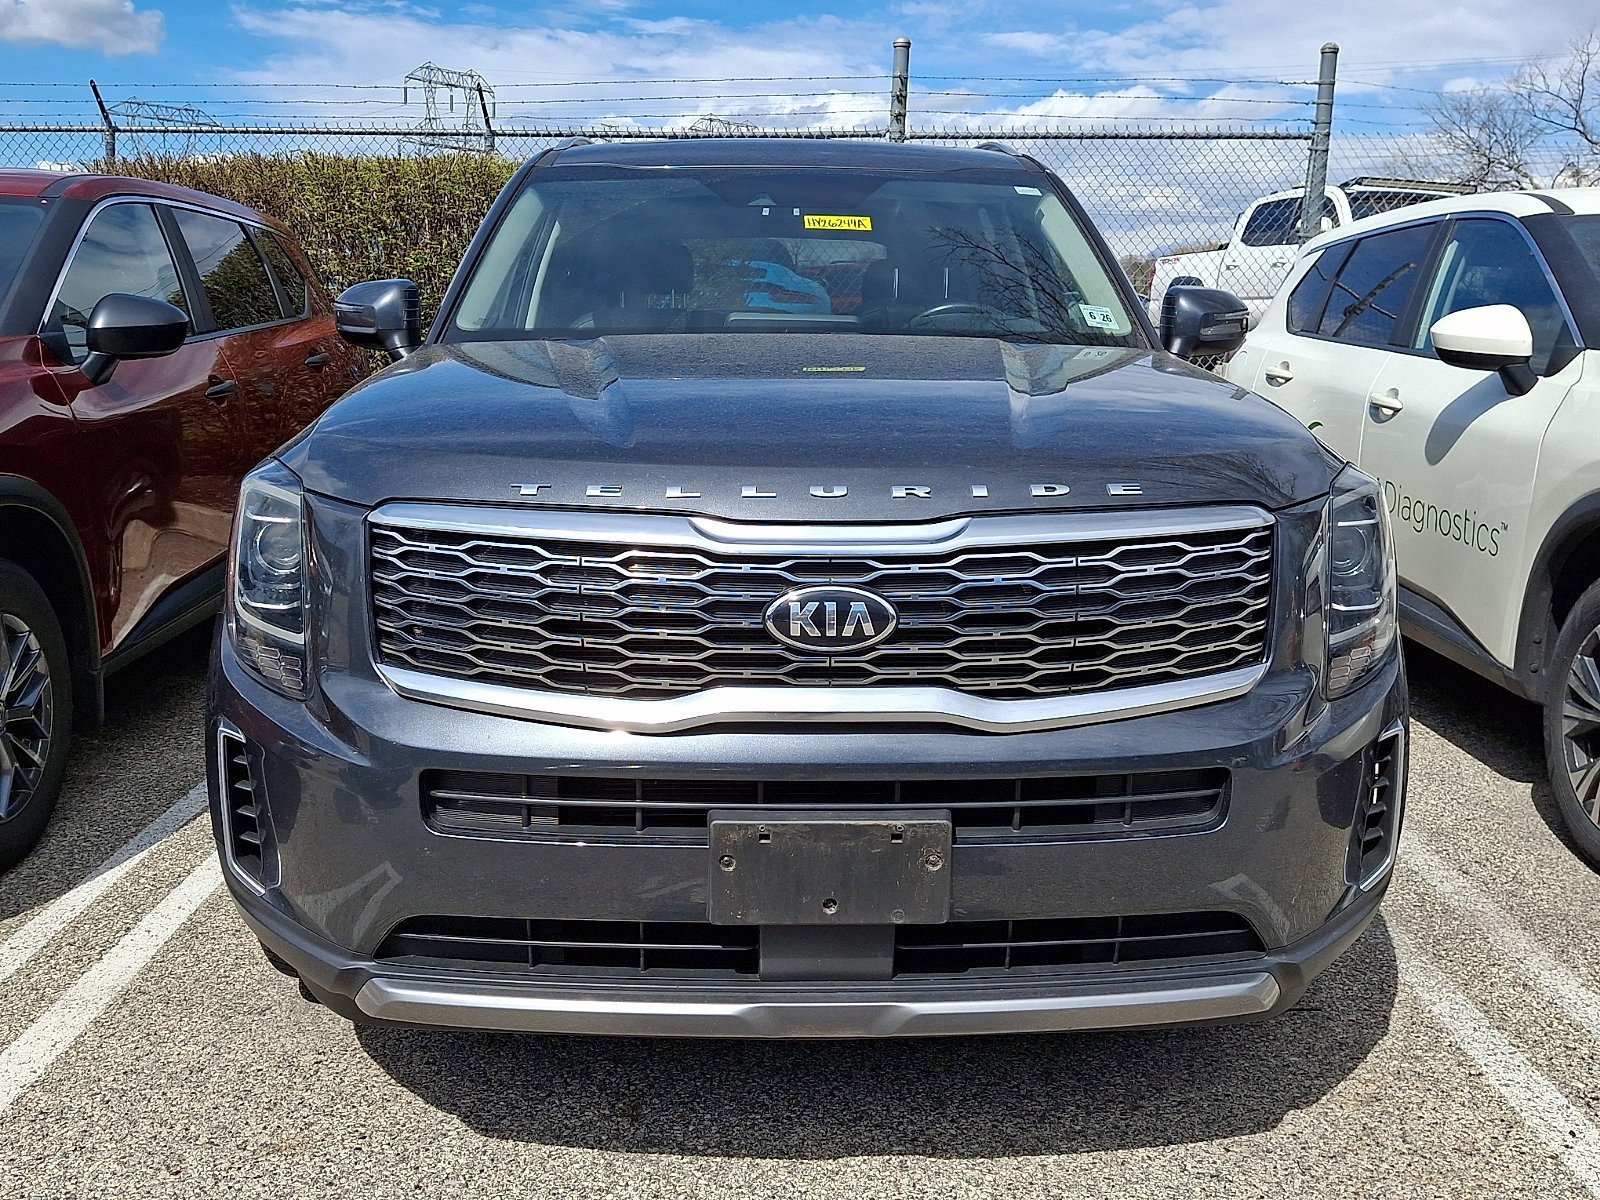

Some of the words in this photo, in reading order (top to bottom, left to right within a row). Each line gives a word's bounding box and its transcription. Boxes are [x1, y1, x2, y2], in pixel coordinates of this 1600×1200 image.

[1089, 311, 1096, 320] 6
[1100, 313, 1112, 322] 26
[509, 482, 1144, 499] TELLURIDE
[788, 601, 876, 637] KIA
